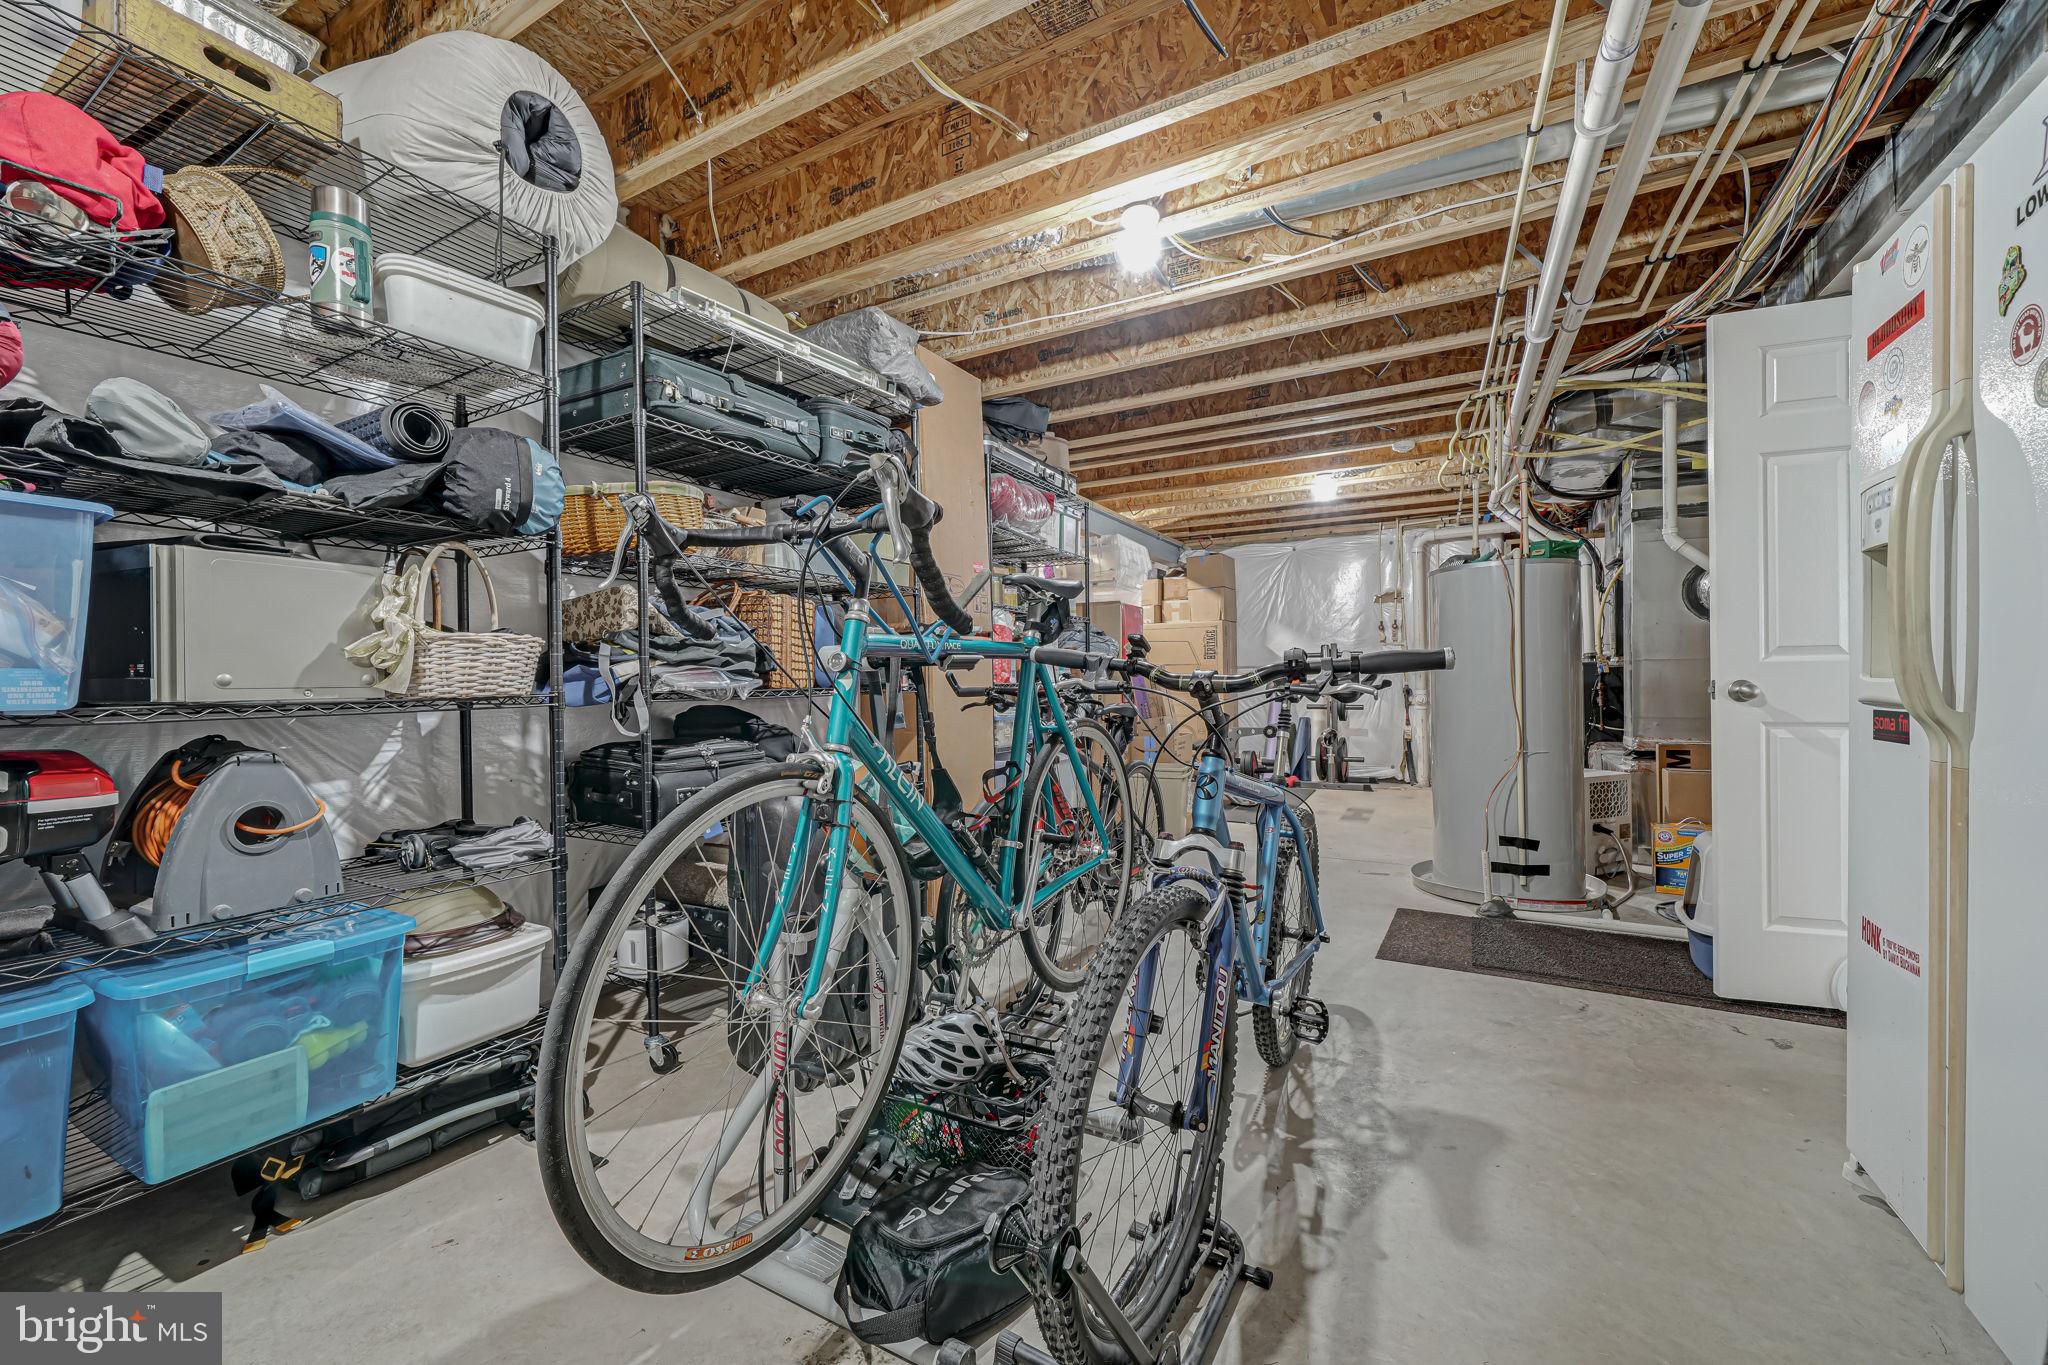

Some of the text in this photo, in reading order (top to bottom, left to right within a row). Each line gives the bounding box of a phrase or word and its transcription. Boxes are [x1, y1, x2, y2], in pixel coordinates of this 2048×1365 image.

[1871, 296, 1920, 350] BLOODSHOT
[502, 482, 512, 511] Skyward
[1206, 629, 1216, 660] HERITAGE
[1874, 715, 1909, 732] soma fm
[1657, 851, 1684, 860] SUPER
[821, 847, 837, 913] KLEIN
[1861, 914, 1882, 954] HONK
[1206, 967, 1228, 1083] MANITOU
